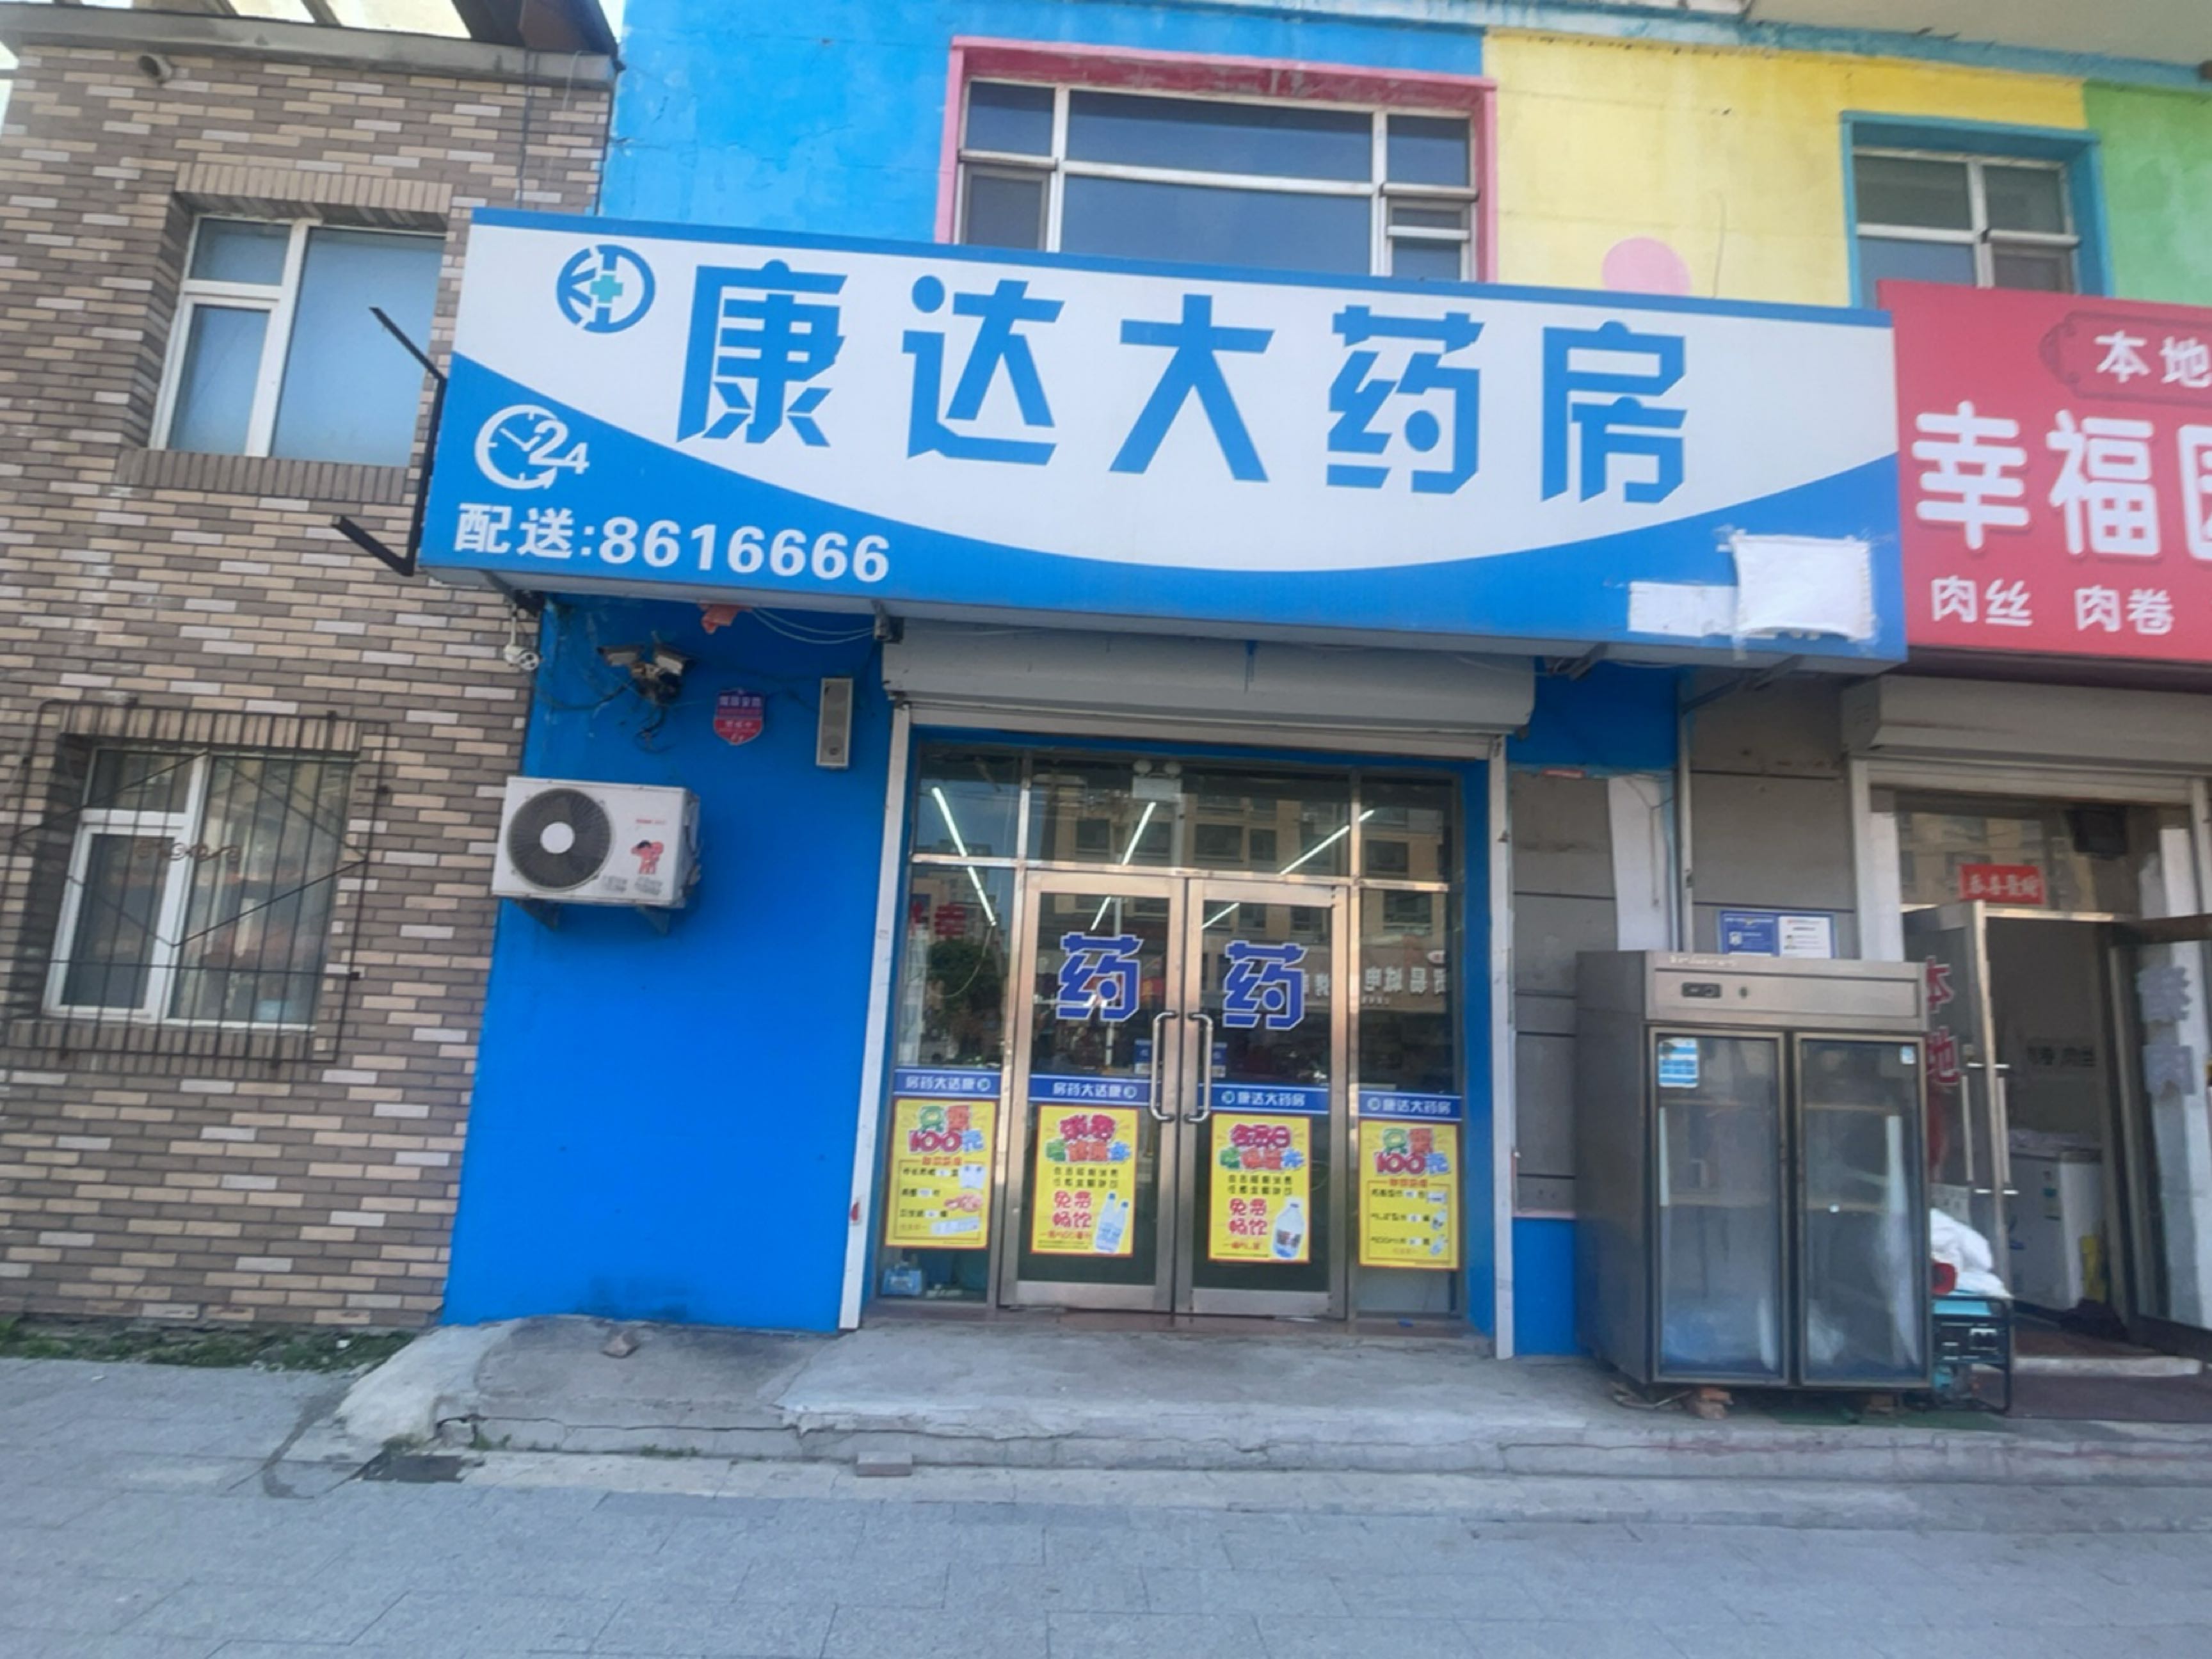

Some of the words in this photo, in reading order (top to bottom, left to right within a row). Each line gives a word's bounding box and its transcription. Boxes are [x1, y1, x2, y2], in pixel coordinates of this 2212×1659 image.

[677, 259, 1688, 504] 康达大药房
[2094, 330, 2212, 389] 本地
[453, 502, 891, 584] 配送:8616666
[1931, 576, 2033, 627] 肉丝
[2075, 585, 2175, 636] 肉卷
[1056, 932, 1144, 1022] 药
[1222, 940, 1309, 1031] 药
[1237, 1091, 1306, 1107] 康达大药房
[1382, 1098, 1451, 1114] 康达大药房
